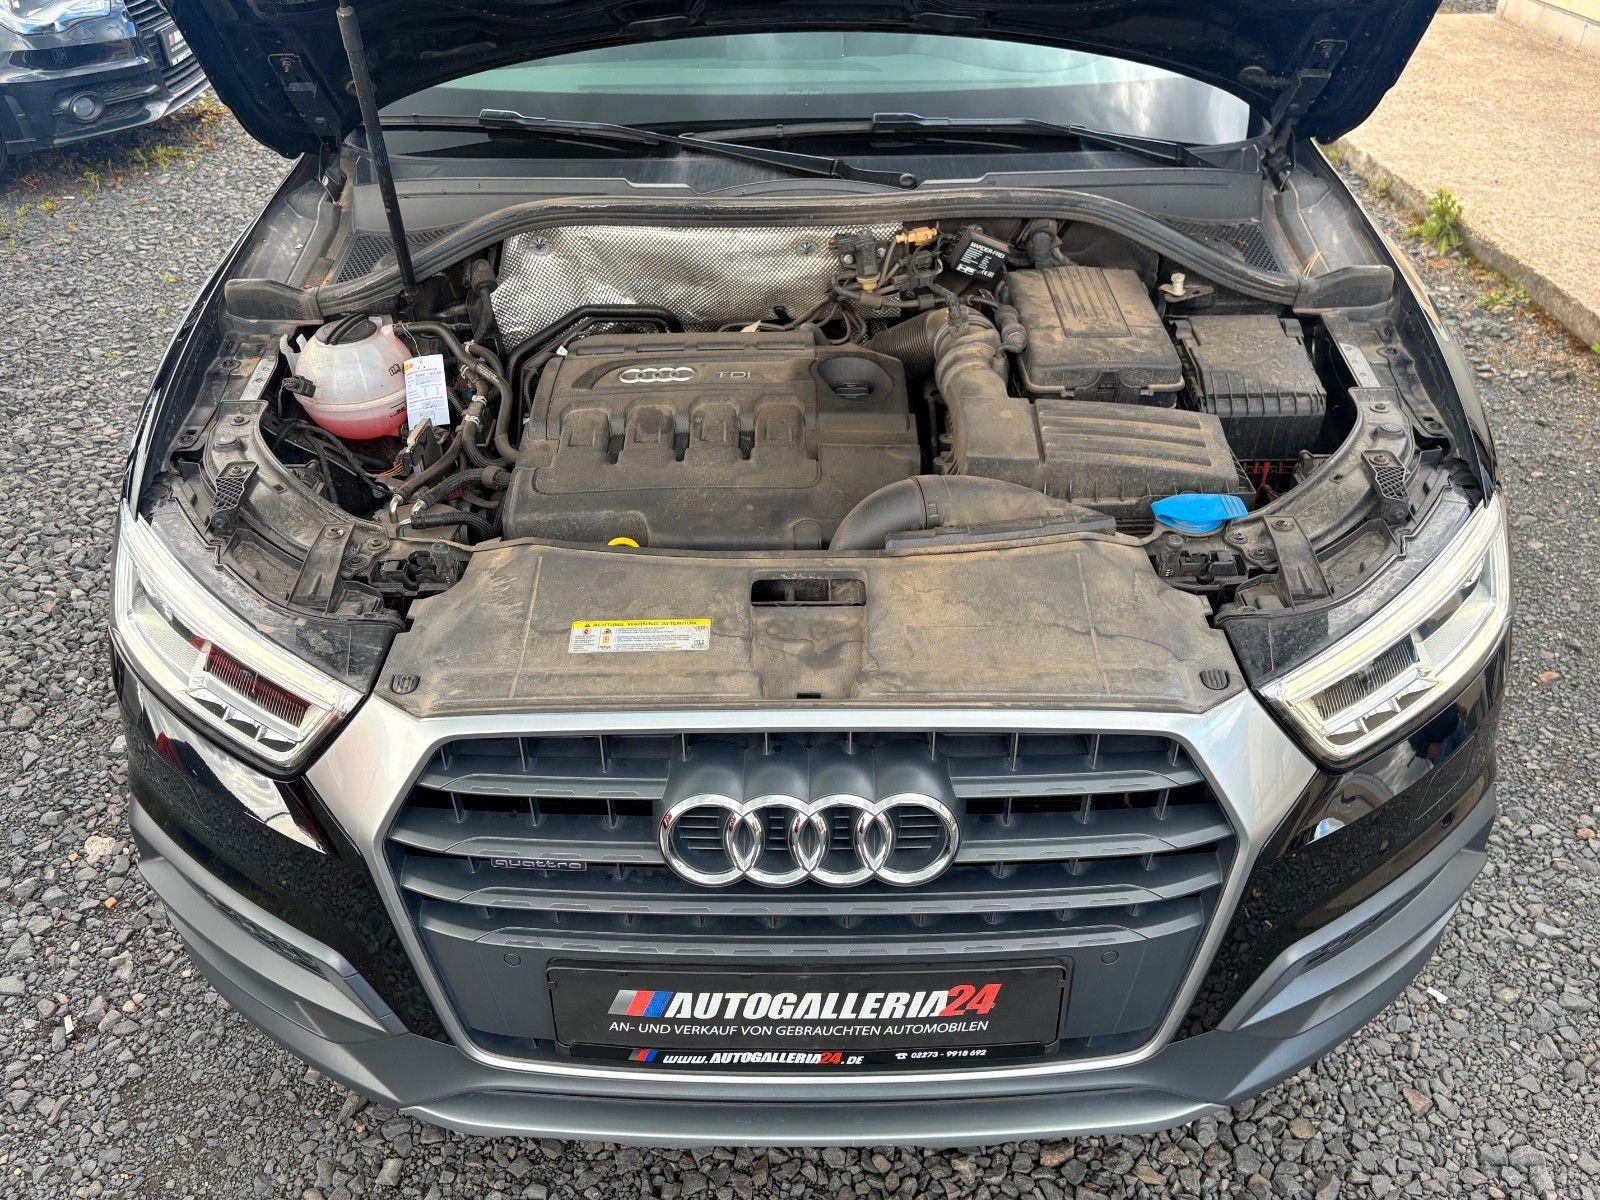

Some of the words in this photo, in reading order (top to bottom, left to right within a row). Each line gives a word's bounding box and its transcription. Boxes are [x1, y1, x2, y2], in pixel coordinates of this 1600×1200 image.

[714, 371, 751, 379] TDI
[495, 859, 582, 869] quattro
[664, 983, 1003, 1020] AUTOGALLERIA24
[609, 1021, 635, 1032] AN-
[638, 1023, 671, 1034] UND
[674, 1025, 738, 1036] VERKAUF
[741, 1025, 772, 1036] VON
[775, 1024, 881, 1036] GEBRAUCHTEN
[883, 1020, 989, 1035] AUTOMOBILEN
[946, 1050, 968, 1058] 9918
[970, 1049, 987, 1057] 692
